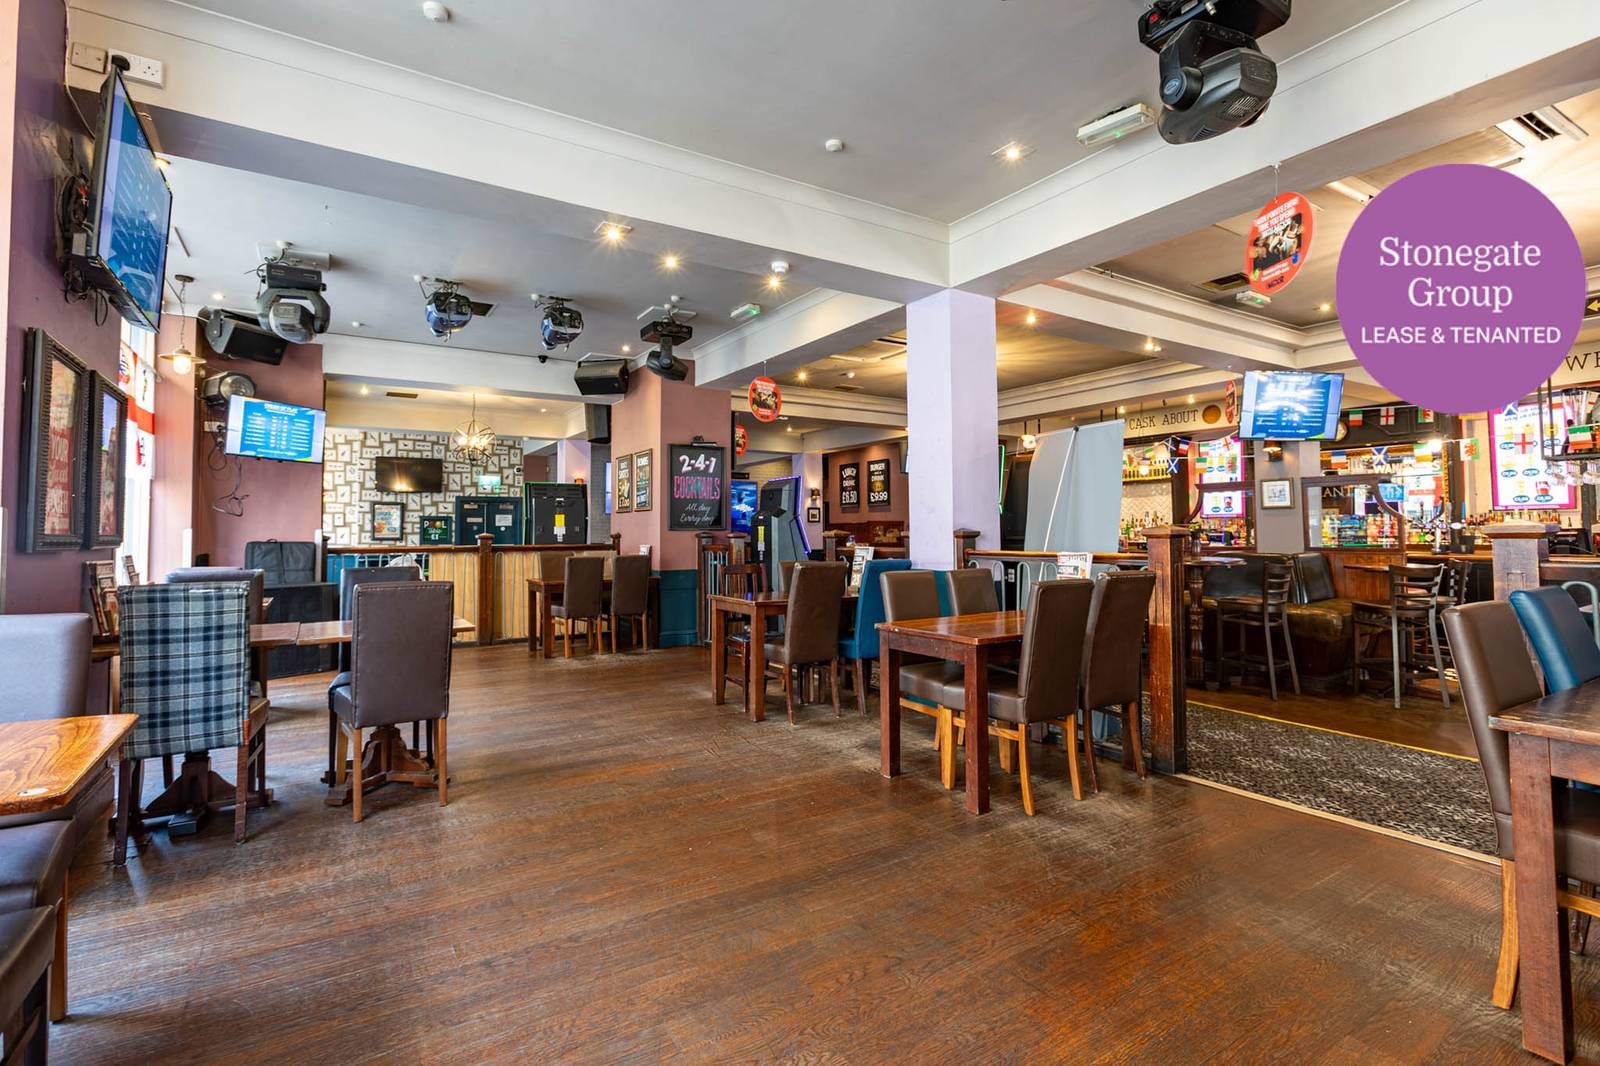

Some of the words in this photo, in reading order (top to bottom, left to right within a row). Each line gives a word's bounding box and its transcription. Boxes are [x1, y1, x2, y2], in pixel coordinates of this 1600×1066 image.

[1129, 416, 1156, 430] CASK
[1162, 410, 1199, 426] ABOUT
[679, 454, 716, 473] 2-4-1
[673, 476, 720, 499] COCKTAILS
[870, 491, 888, 502] £9.99
[685, 503, 698, 512] All
